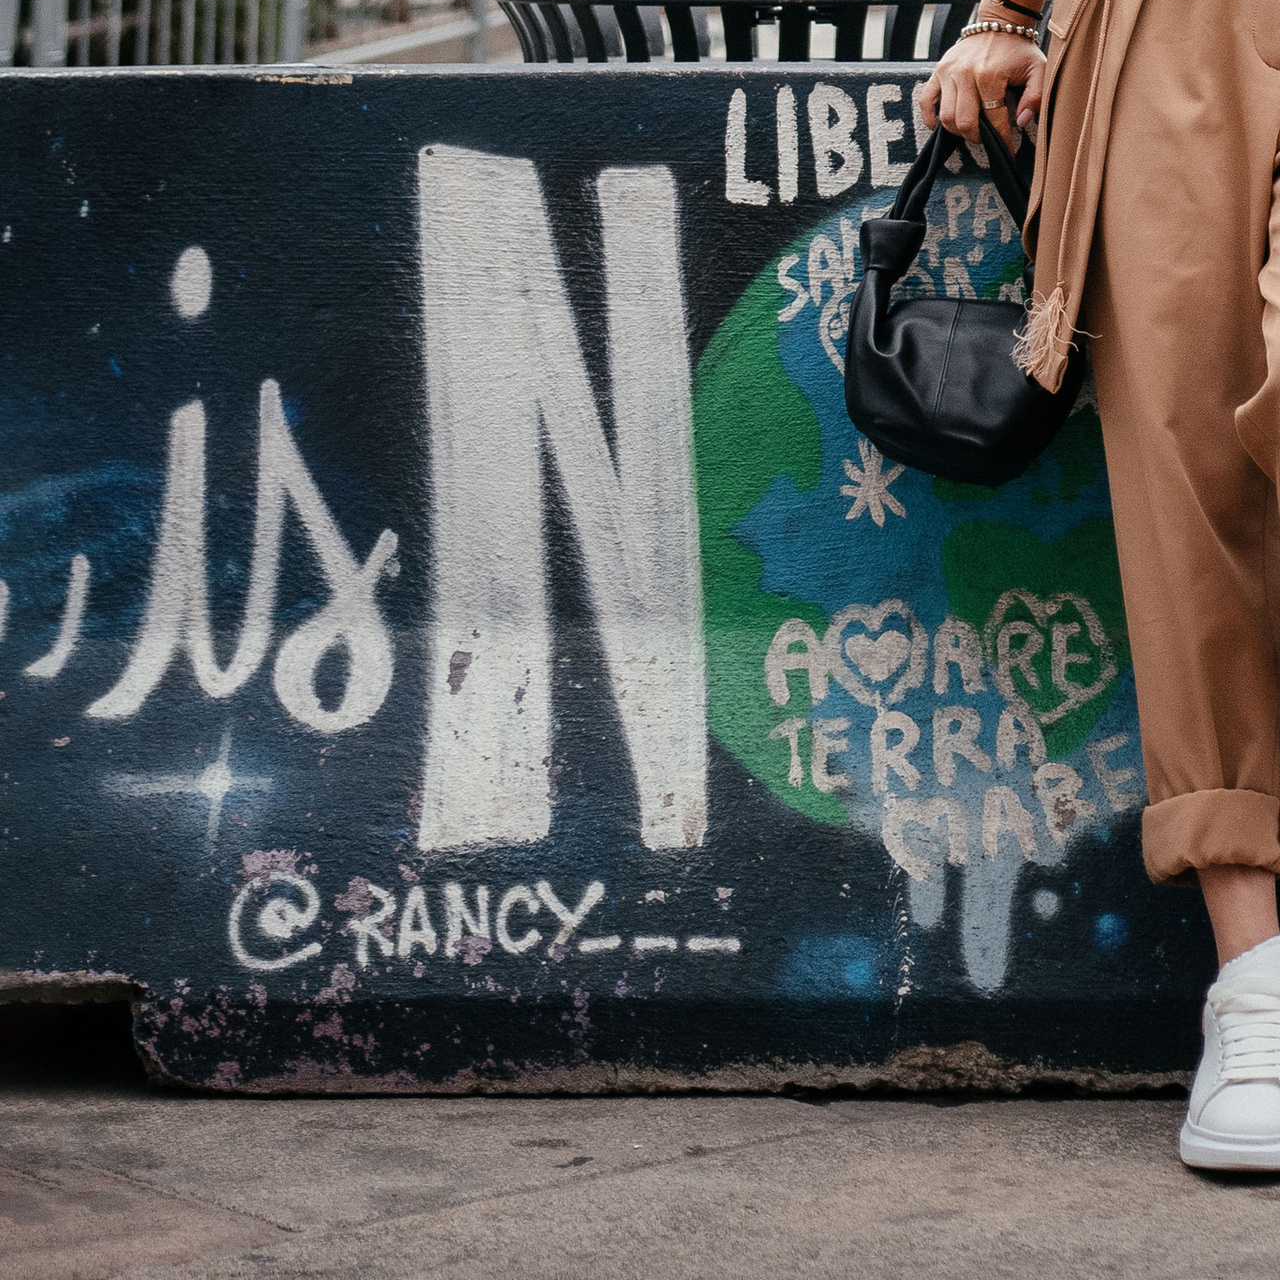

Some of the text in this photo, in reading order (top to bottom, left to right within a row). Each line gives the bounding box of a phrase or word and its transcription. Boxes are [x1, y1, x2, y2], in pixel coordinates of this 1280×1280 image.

[417, 142, 710, 852] N
[768, 705, 1048, 797] TERRA
[881, 734, 1143, 883] MARE
